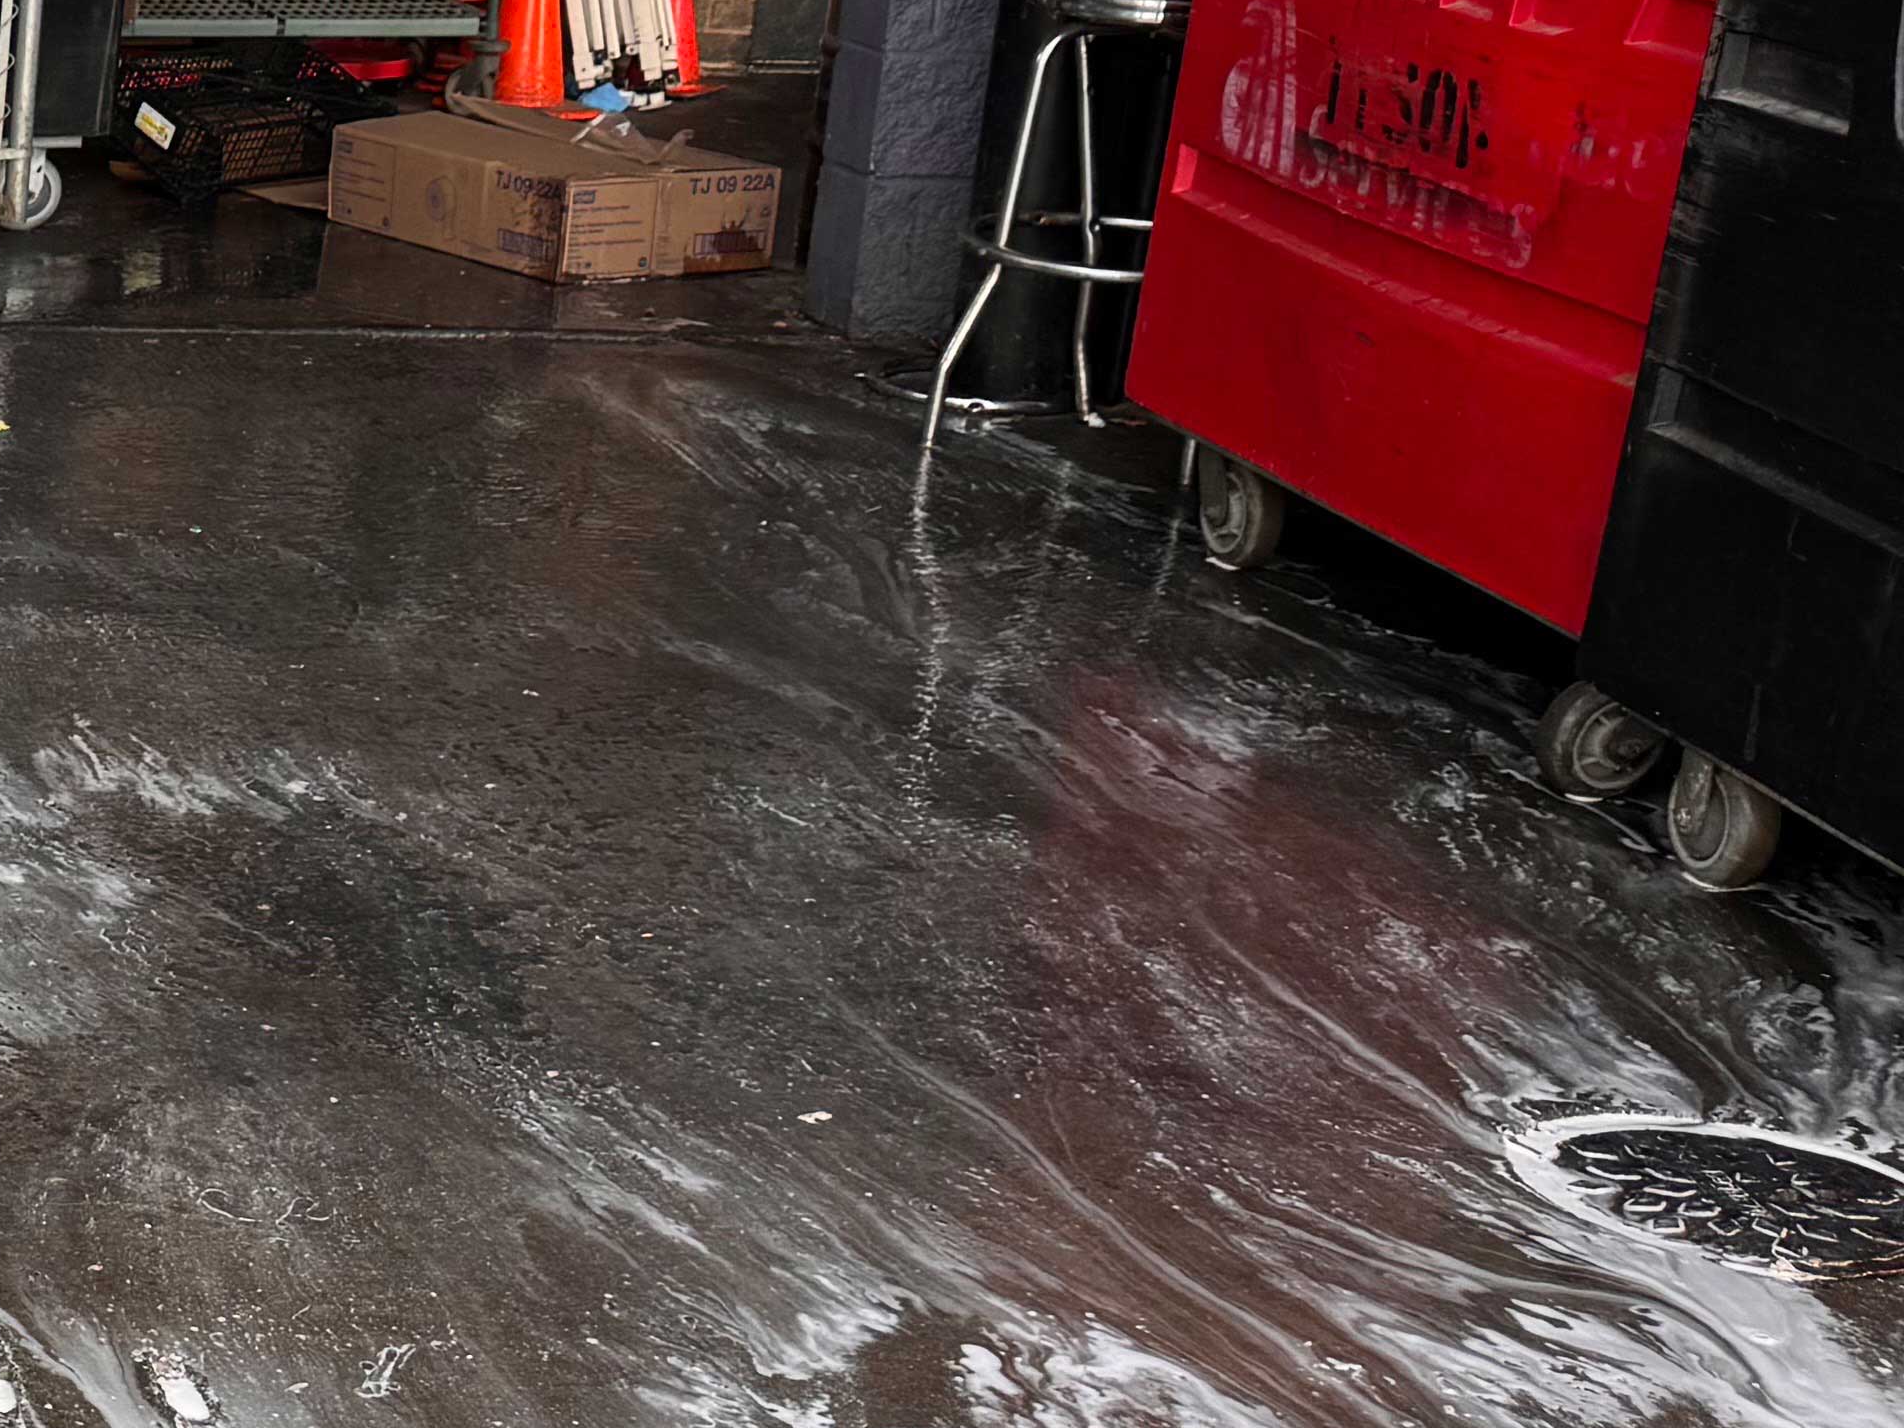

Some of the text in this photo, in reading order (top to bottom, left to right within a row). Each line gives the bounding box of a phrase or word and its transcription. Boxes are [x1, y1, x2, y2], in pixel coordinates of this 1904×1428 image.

[689, 173, 777, 196] TJ 09 22A
